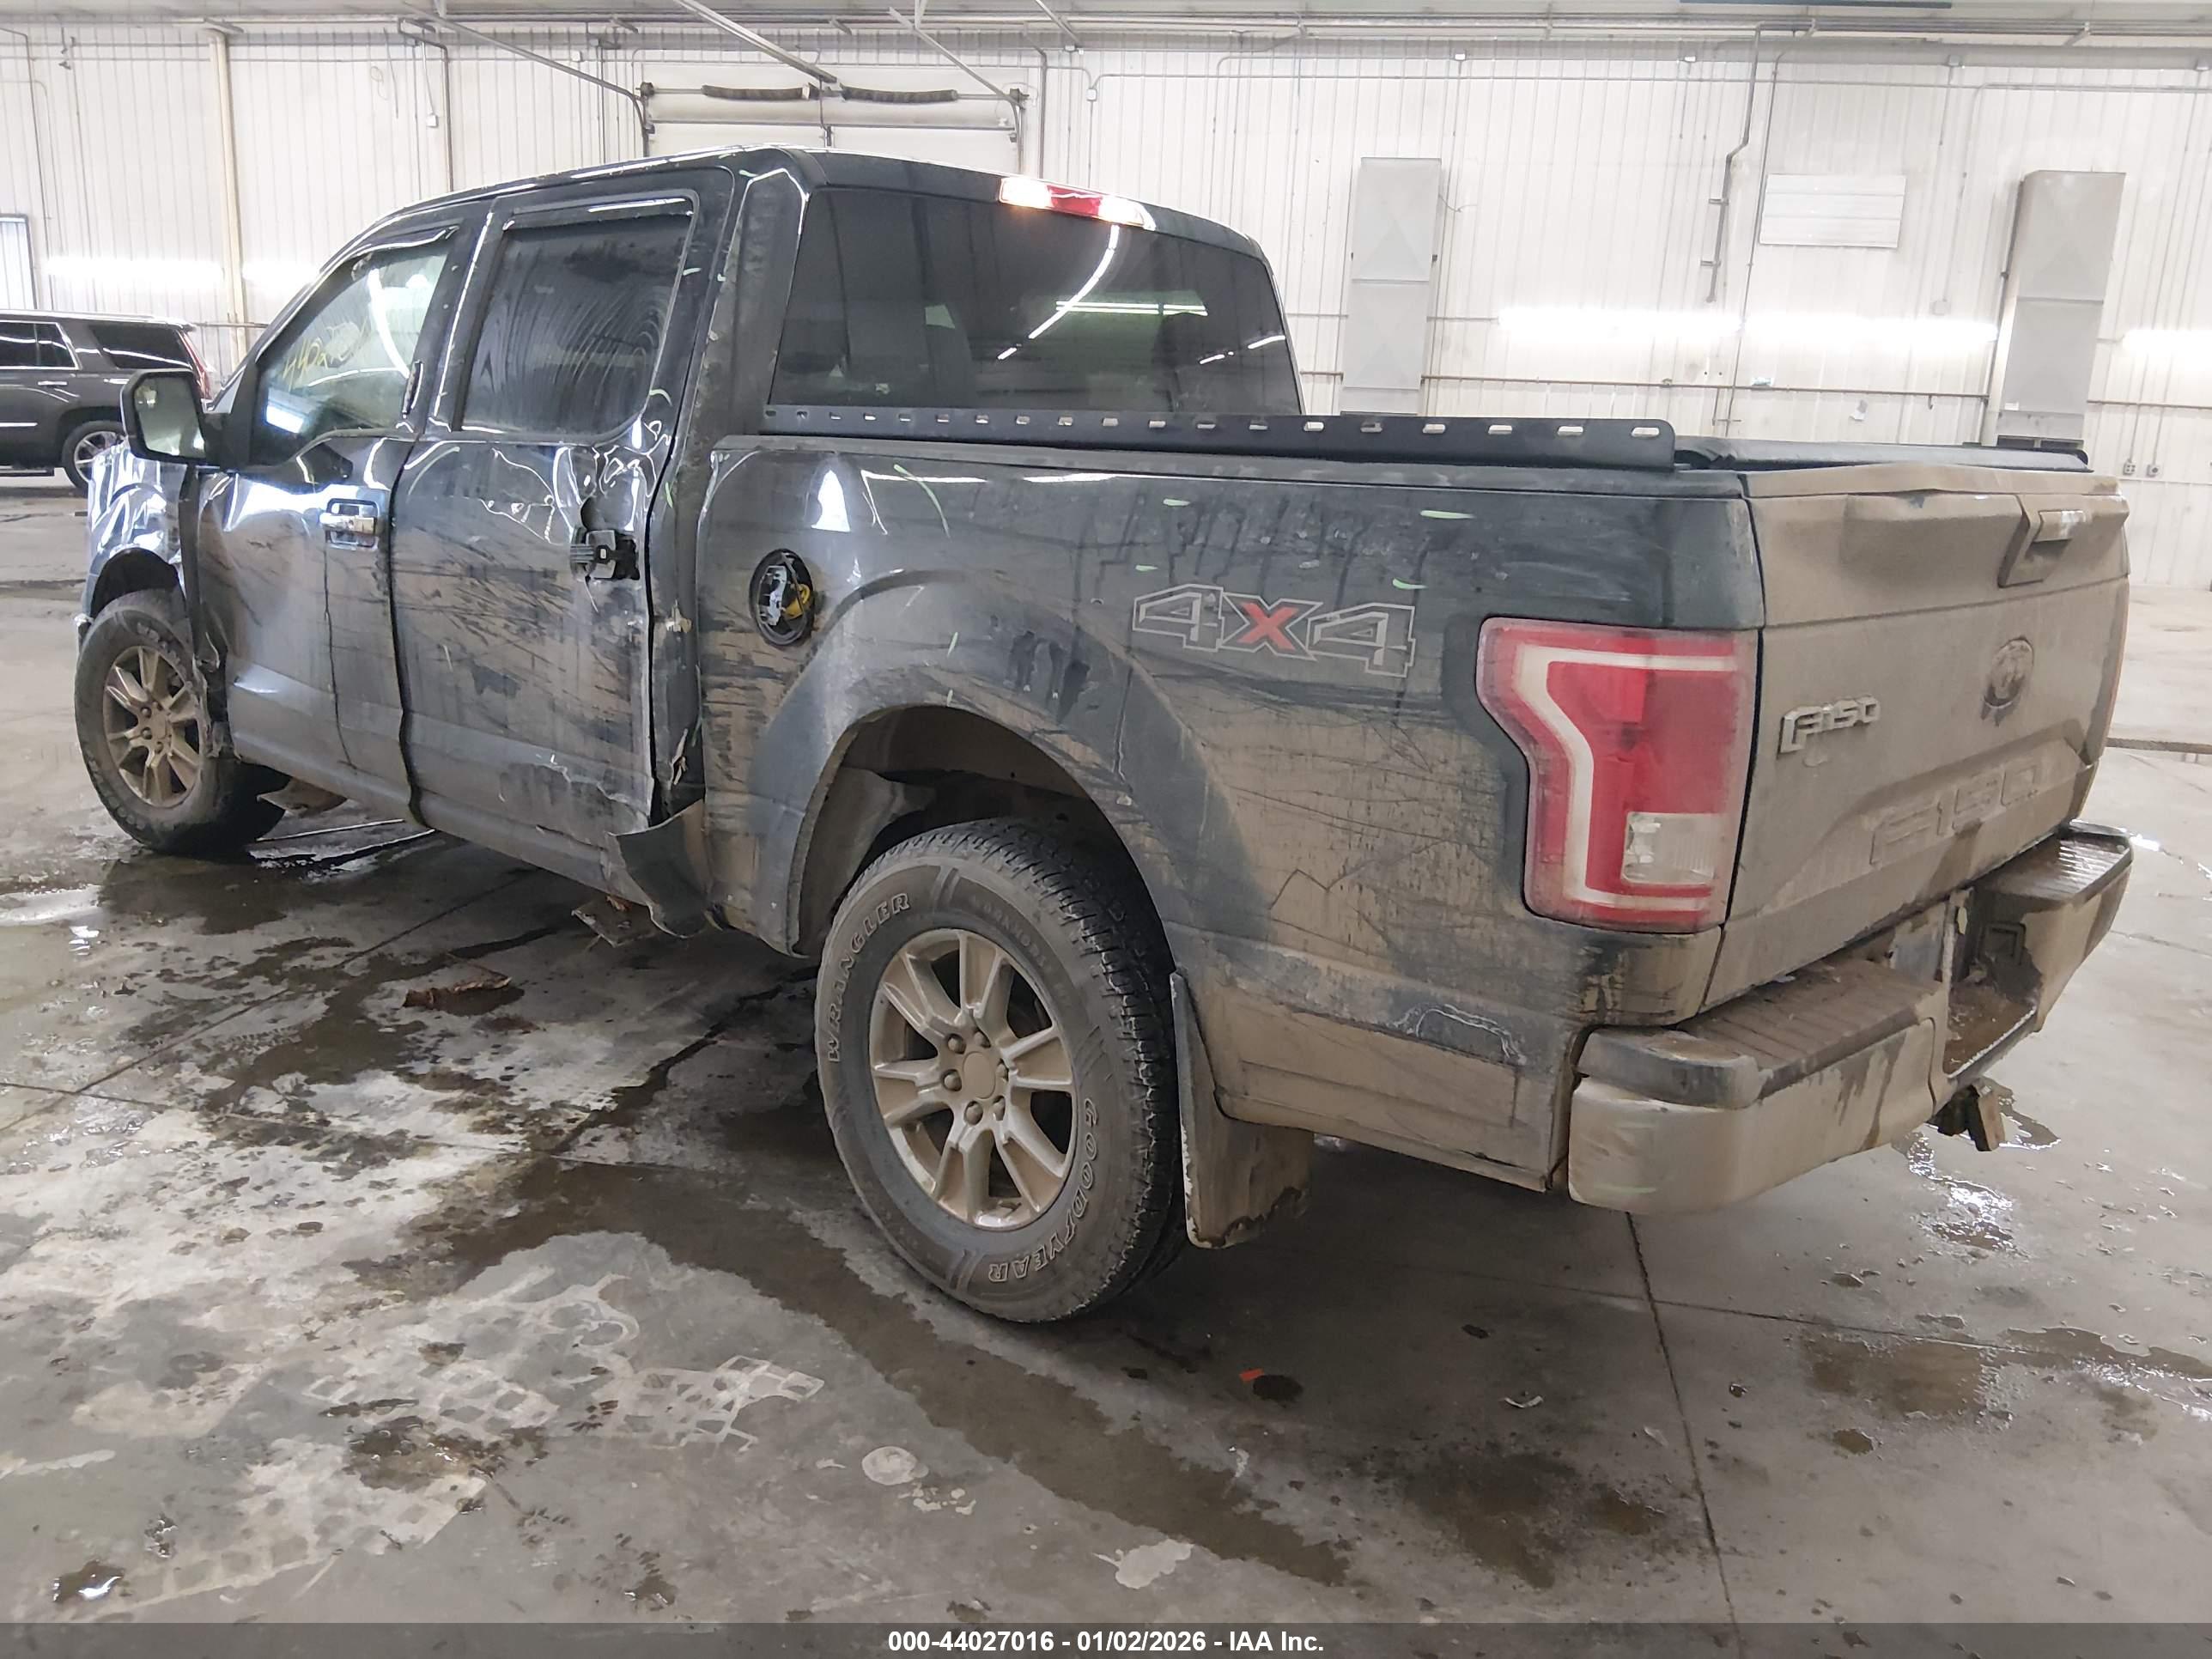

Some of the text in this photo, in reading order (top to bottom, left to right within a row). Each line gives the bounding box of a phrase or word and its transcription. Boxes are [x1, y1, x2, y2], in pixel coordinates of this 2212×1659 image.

[1777, 694, 1881, 757] F150
[828, 892, 911, 1063] WRANGLER
[988, 1097, 1099, 1284] GOODYEAR
